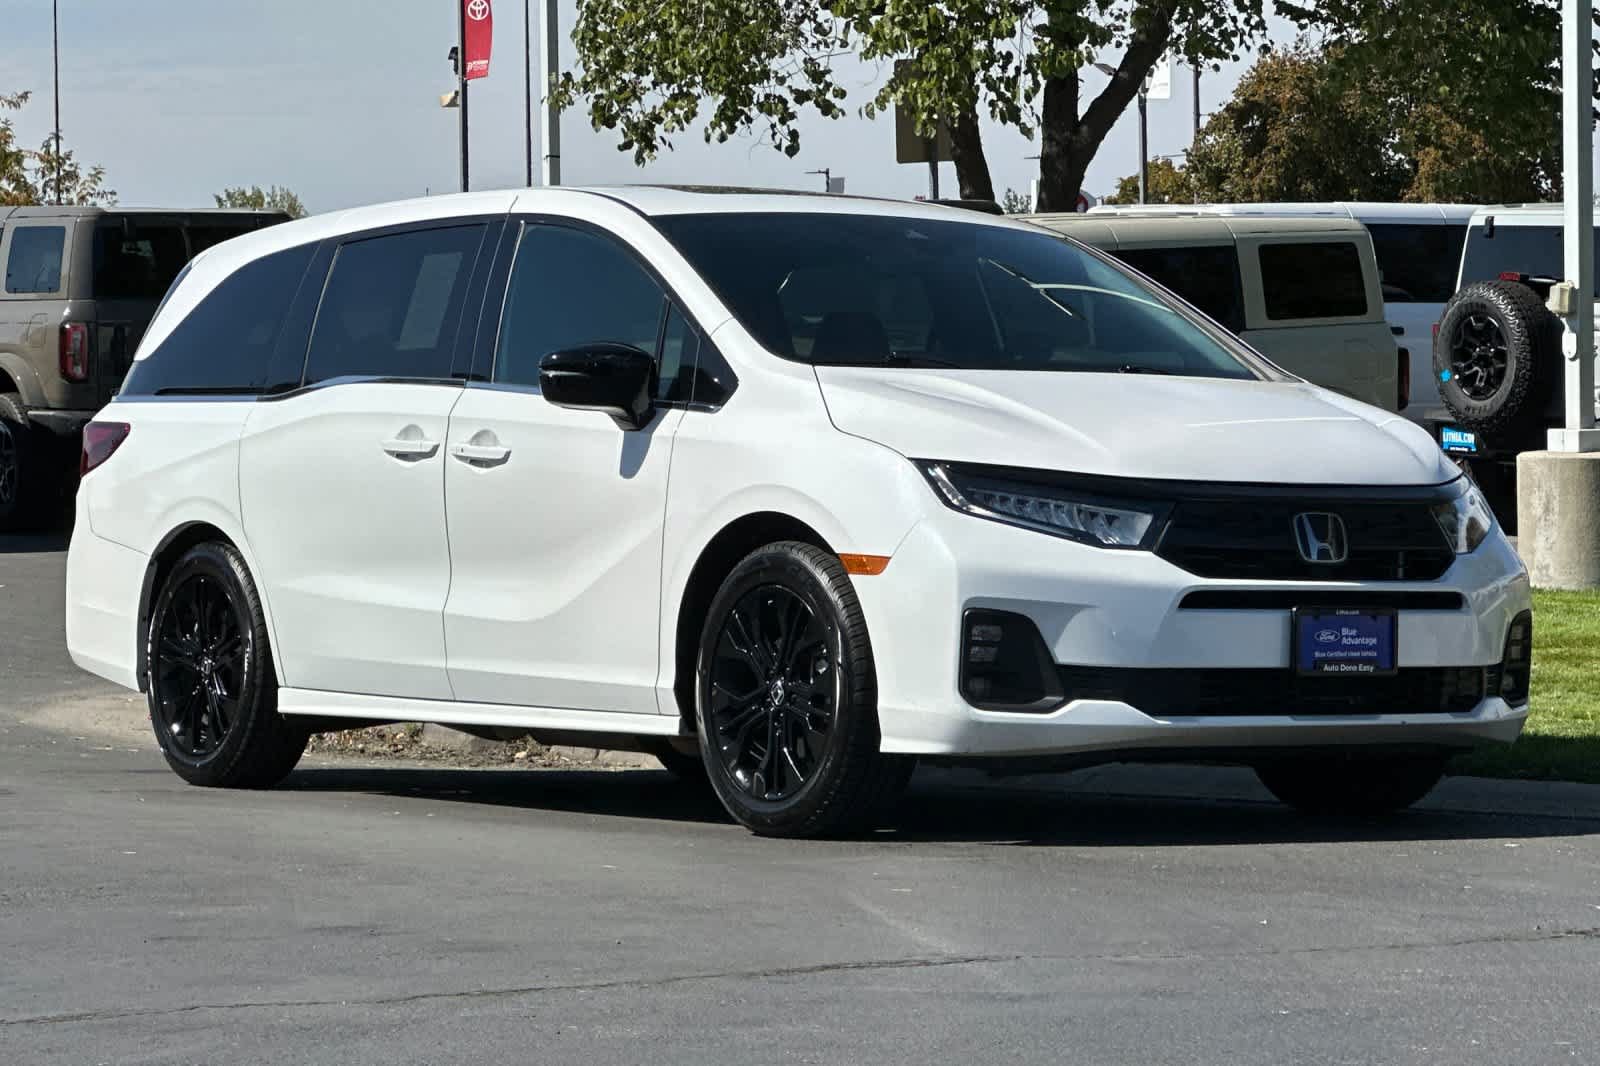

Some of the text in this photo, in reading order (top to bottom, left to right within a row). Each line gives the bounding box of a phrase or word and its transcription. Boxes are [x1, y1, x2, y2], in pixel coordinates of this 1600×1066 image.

[1341, 627, 1357, 636] Blue
[1341, 636, 1377, 646] Advantage
[1323, 663, 1374, 672] Auto Done Easy
